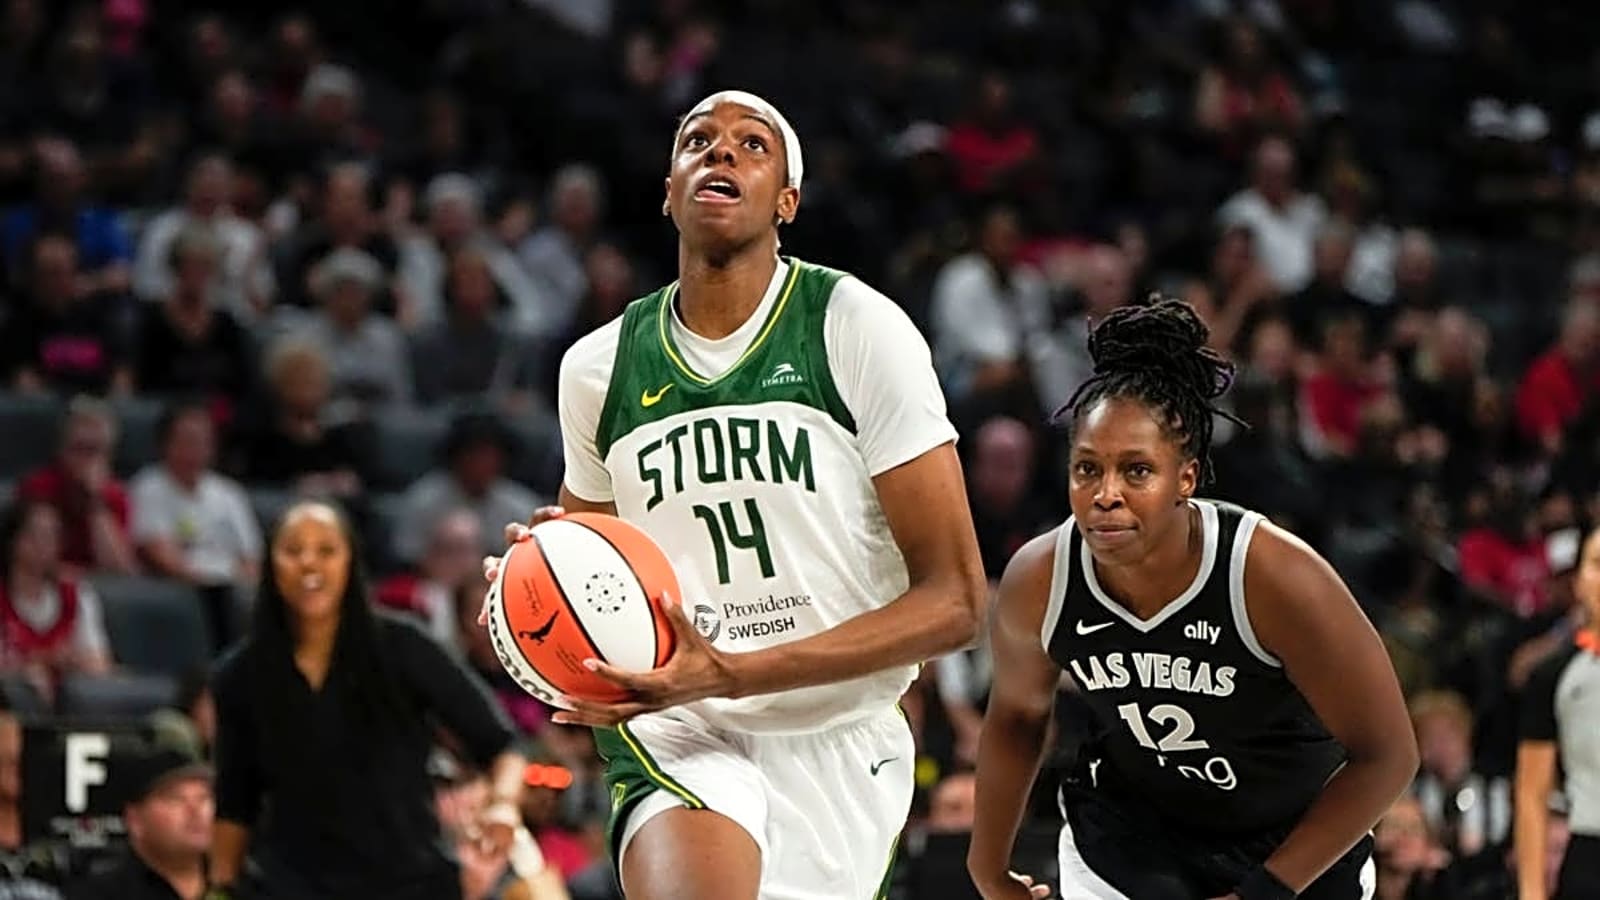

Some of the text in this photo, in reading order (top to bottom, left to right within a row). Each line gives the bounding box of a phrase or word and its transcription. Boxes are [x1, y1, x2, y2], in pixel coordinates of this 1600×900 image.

[637, 417, 816, 512] STORM
[692, 498, 775, 585] 14
[723, 595, 811, 619] Providence
[728, 616, 796, 640] SWEDISH
[1184, 620, 1221, 645] ally
[1070, 652, 1237, 697] LAS VEGAS
[1117, 702, 1210, 751] 12
[65, 732, 110, 813] F
